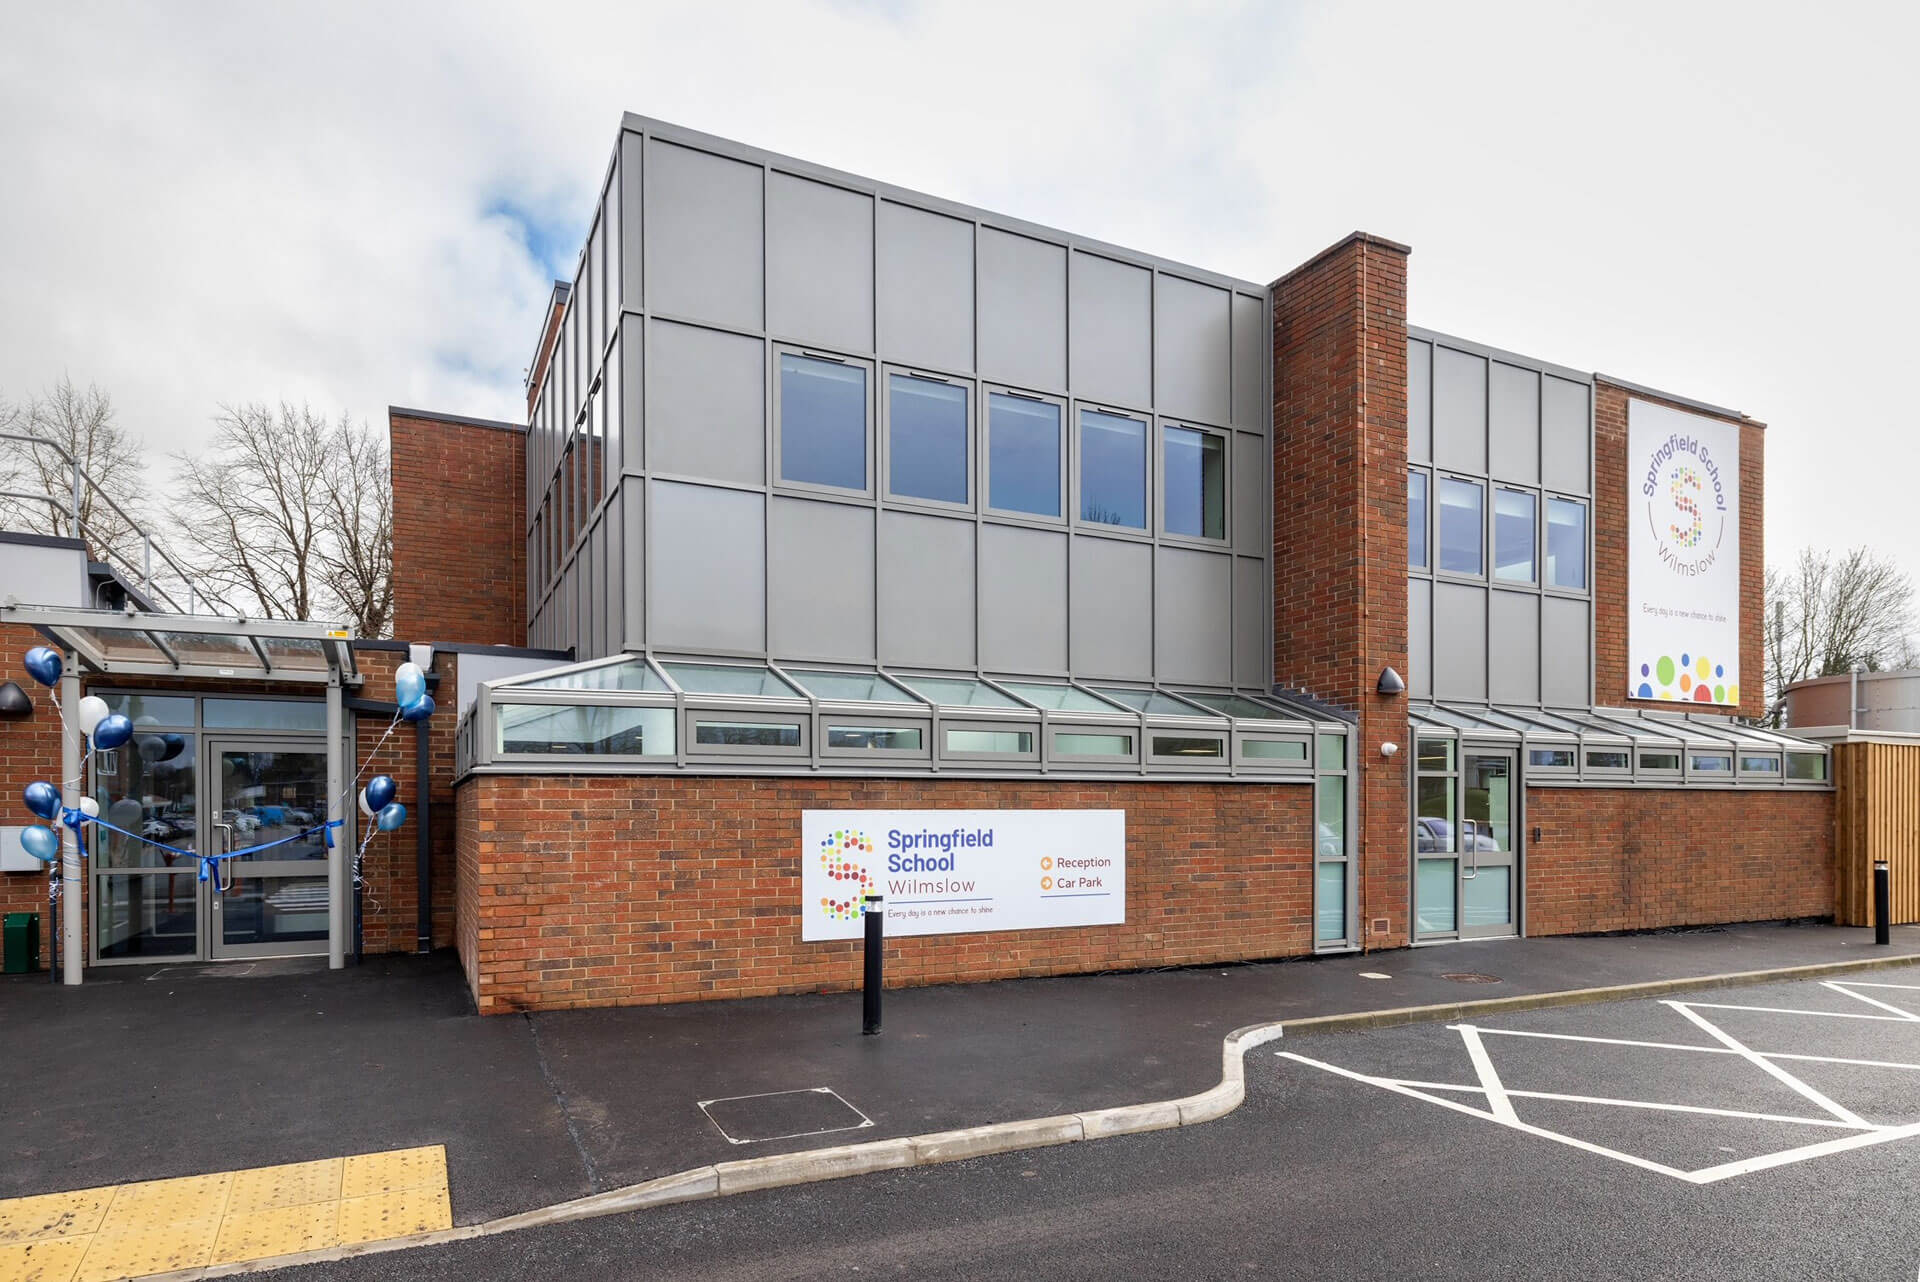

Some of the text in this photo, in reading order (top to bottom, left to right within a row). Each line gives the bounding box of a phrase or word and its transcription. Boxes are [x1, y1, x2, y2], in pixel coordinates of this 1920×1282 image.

[1642, 433, 1727, 511] Springfield School
[1658, 541, 1716, 577] Wilmslow
[888, 828, 993, 853] Springfield
[888, 852, 954, 873] School
[1057, 857, 1111, 870] Reception
[888, 878, 975, 895] Wilmslow
[1057, 877, 1103, 888] Car Park
[888, 908, 906, 919] Every
[908, 907, 919, 919] day
[920, 907, 926, 916] is
[927, 909, 932, 917] a
[948, 906, 969, 915] chance
[970, 905, 977, 914] to
[978, 904, 993, 913] shine
